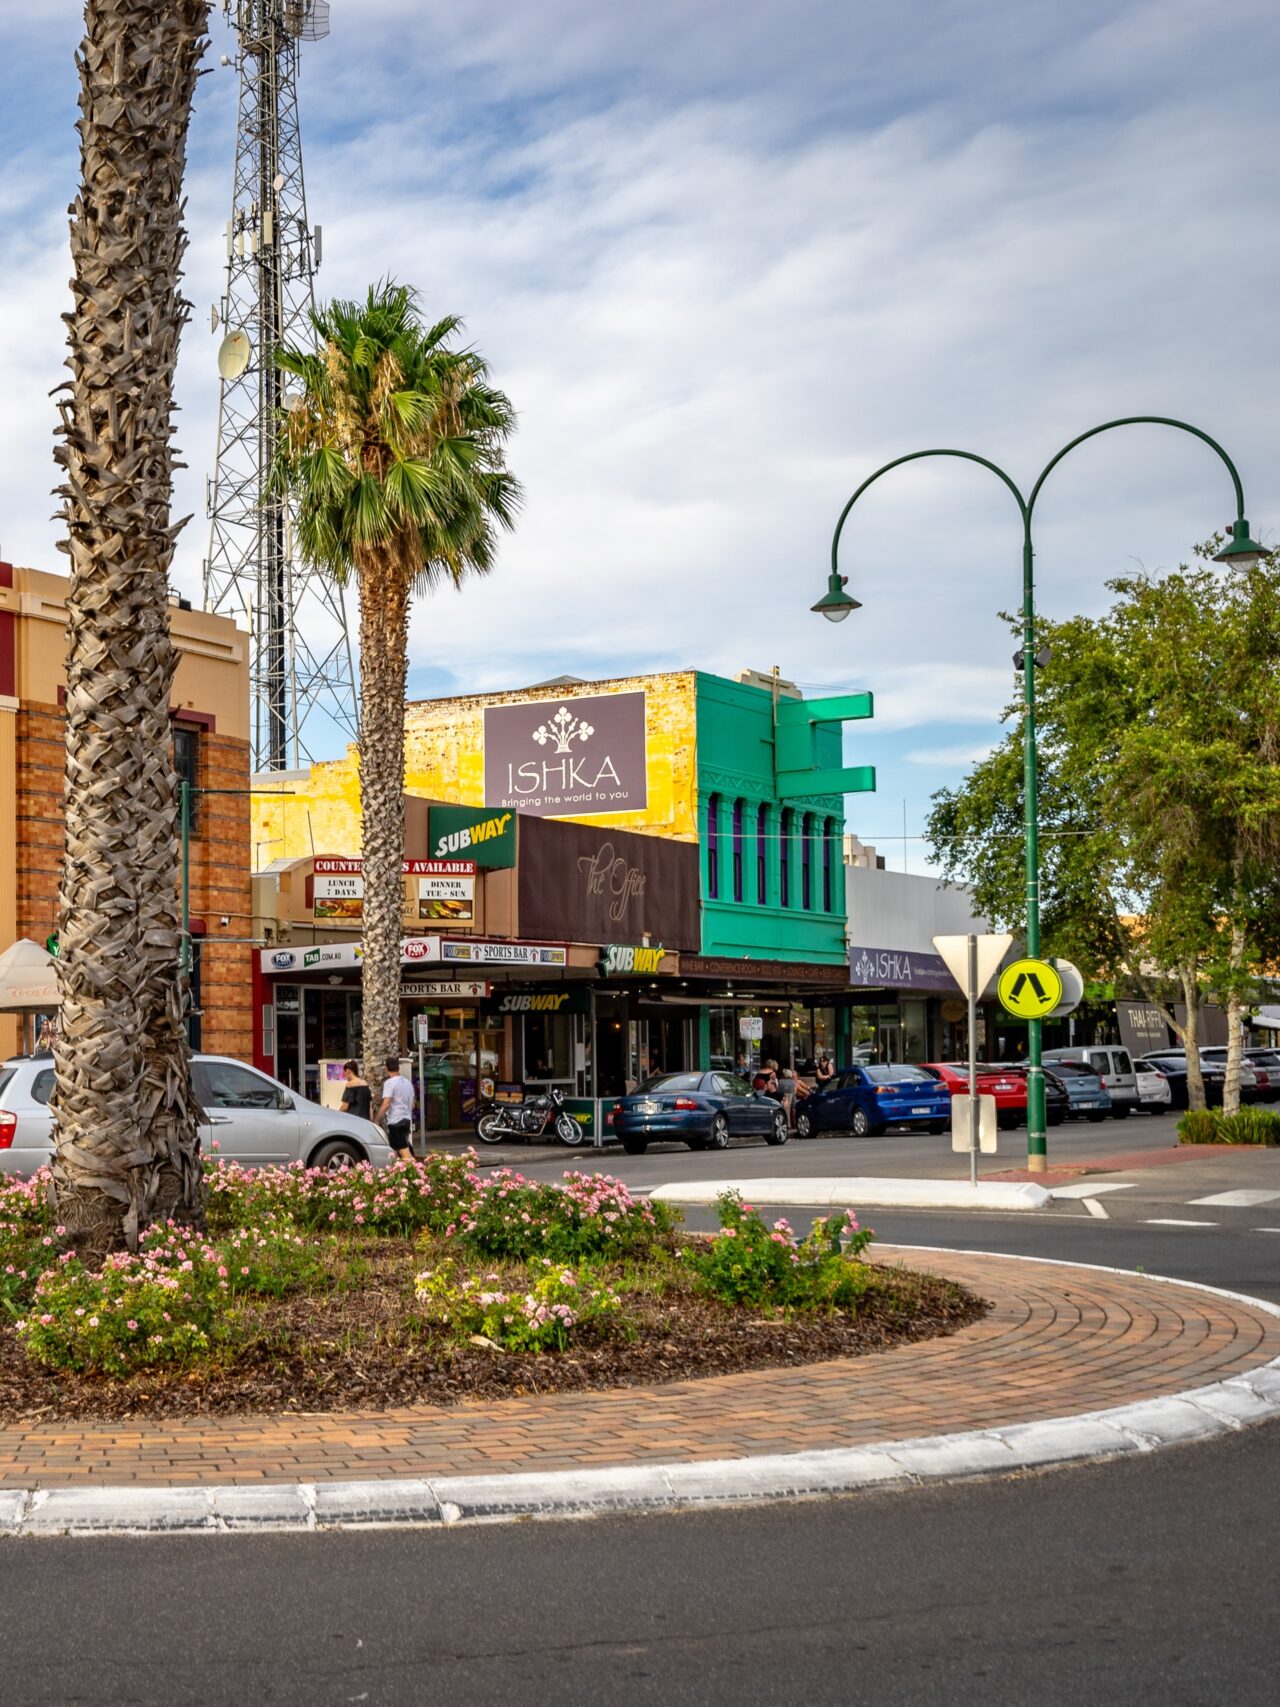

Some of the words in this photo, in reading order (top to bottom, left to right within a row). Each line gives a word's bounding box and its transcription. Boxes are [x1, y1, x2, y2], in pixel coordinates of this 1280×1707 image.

[508, 755, 621, 794] ISHKA
[501, 797, 541, 808] Bringing
[544, 795, 561, 804] the
[563, 792, 592, 802] world
[595, 791, 606, 800] to
[609, 790, 629, 801] you
[435, 812, 512, 858] SUBWAY
[315, 860, 363, 872] COUNTE
[412, 862, 474, 873] AVAILABLE
[328, 879, 356, 887] LUNCH
[430, 880, 462, 889] DINNER
[334, 888, 357, 896] DAYS
[426, 889, 442, 897] TUE
[450, 890, 466, 898] SUN
[408, 944, 425, 953] FOX
[484, 945, 512, 958] SPORTS
[513, 947, 528, 959] BAR
[275, 953, 292, 963] FOX
[305, 953, 320, 962] TAB
[605, 946, 665, 972] SUBWAY
[875, 953, 912, 981] ISHKA
[400, 983, 437, 993] SPORTS
[439, 983, 462, 993] BAR
[498, 993, 569, 1012] SUBWAY
